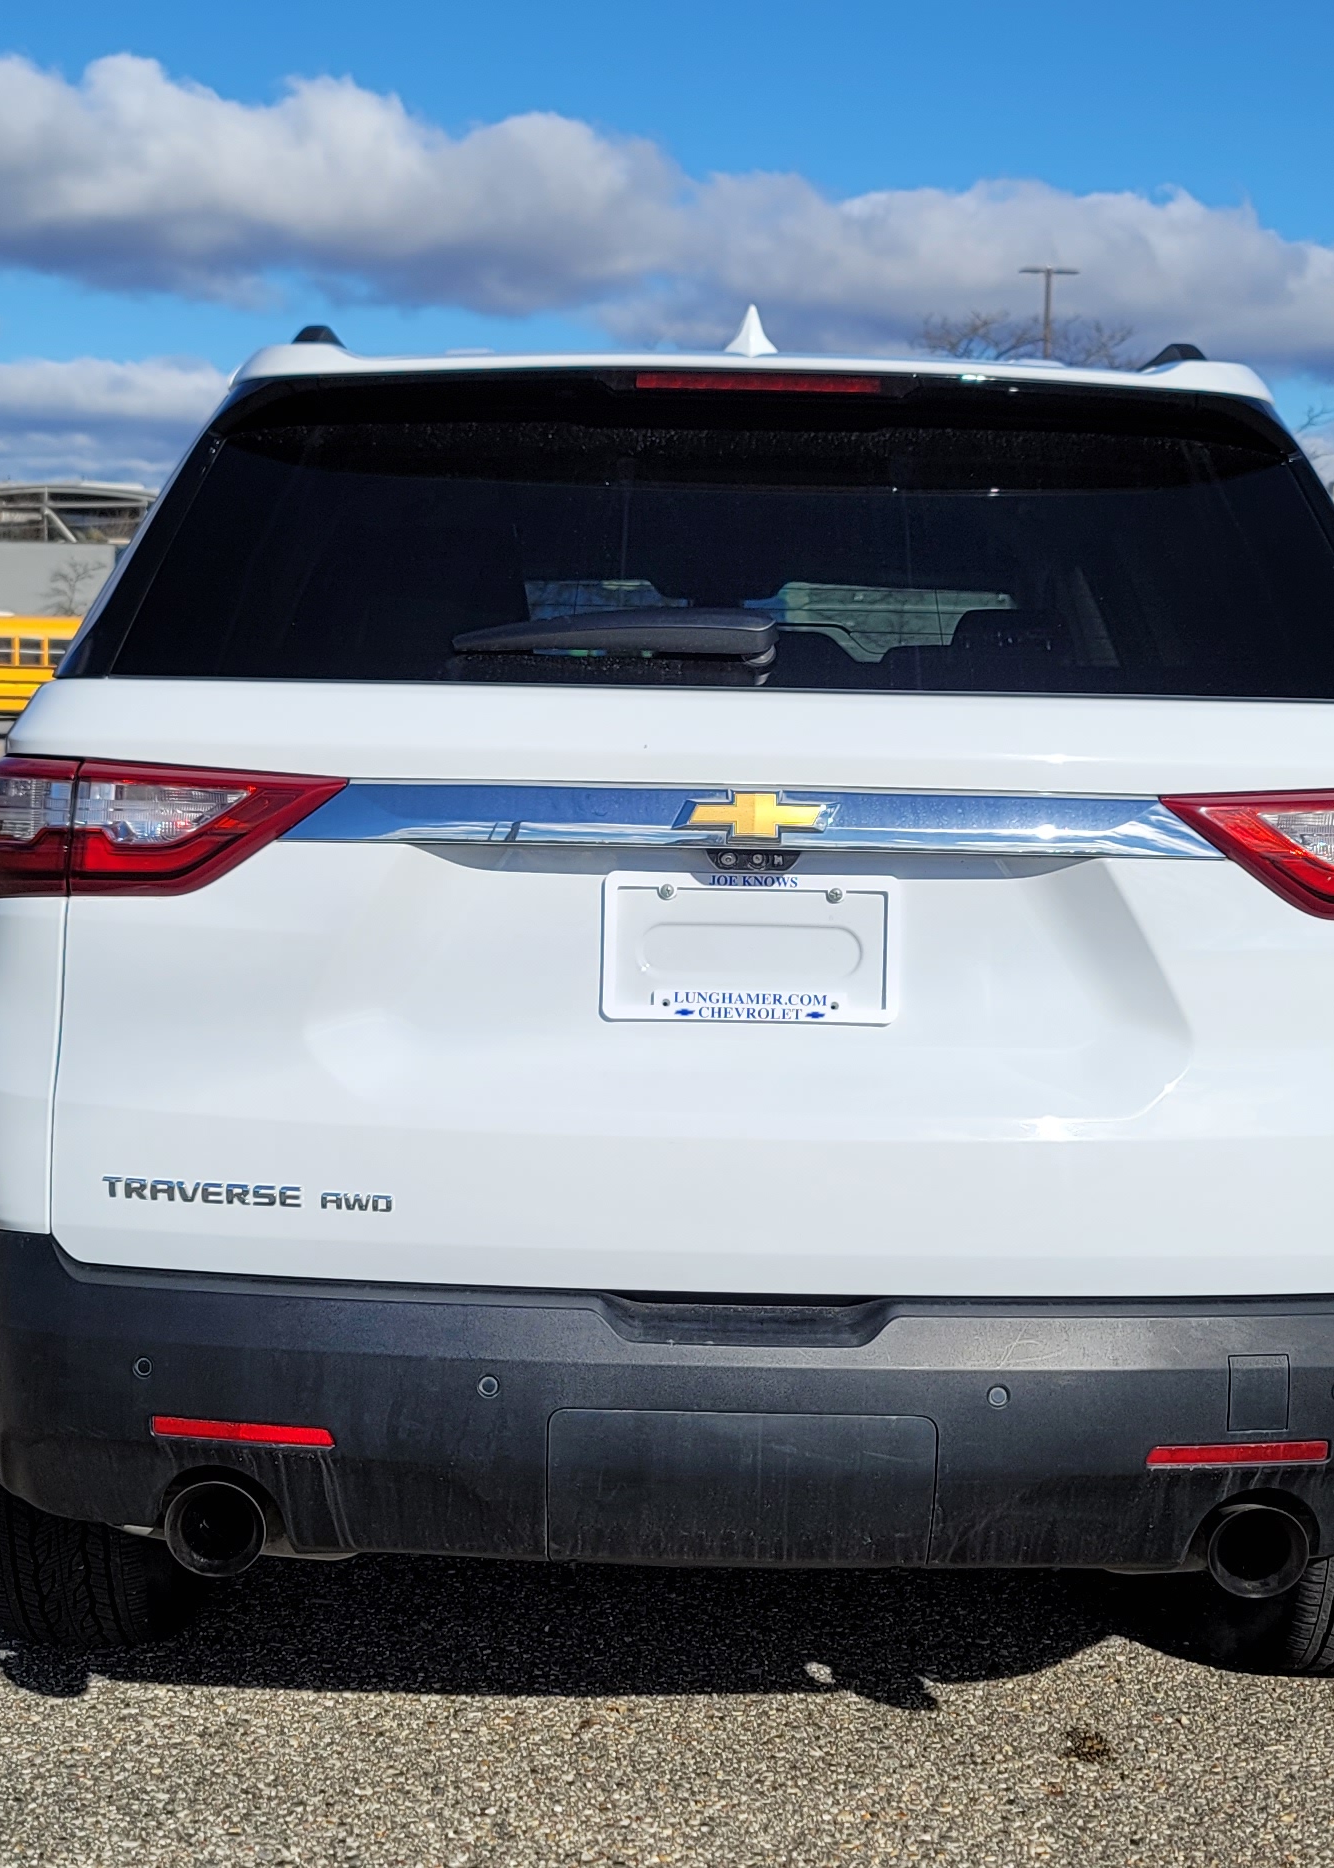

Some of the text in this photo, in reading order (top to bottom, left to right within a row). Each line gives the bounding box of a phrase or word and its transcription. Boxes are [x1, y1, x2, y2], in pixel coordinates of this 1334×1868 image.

[709, 875, 798, 888] JOE KNOWS
[674, 991, 827, 1006] LUNGHAMER.COM
[698, 1006, 802, 1020] CHEVROLET
[102, 1176, 393, 1212] TRAVERSE AWD
